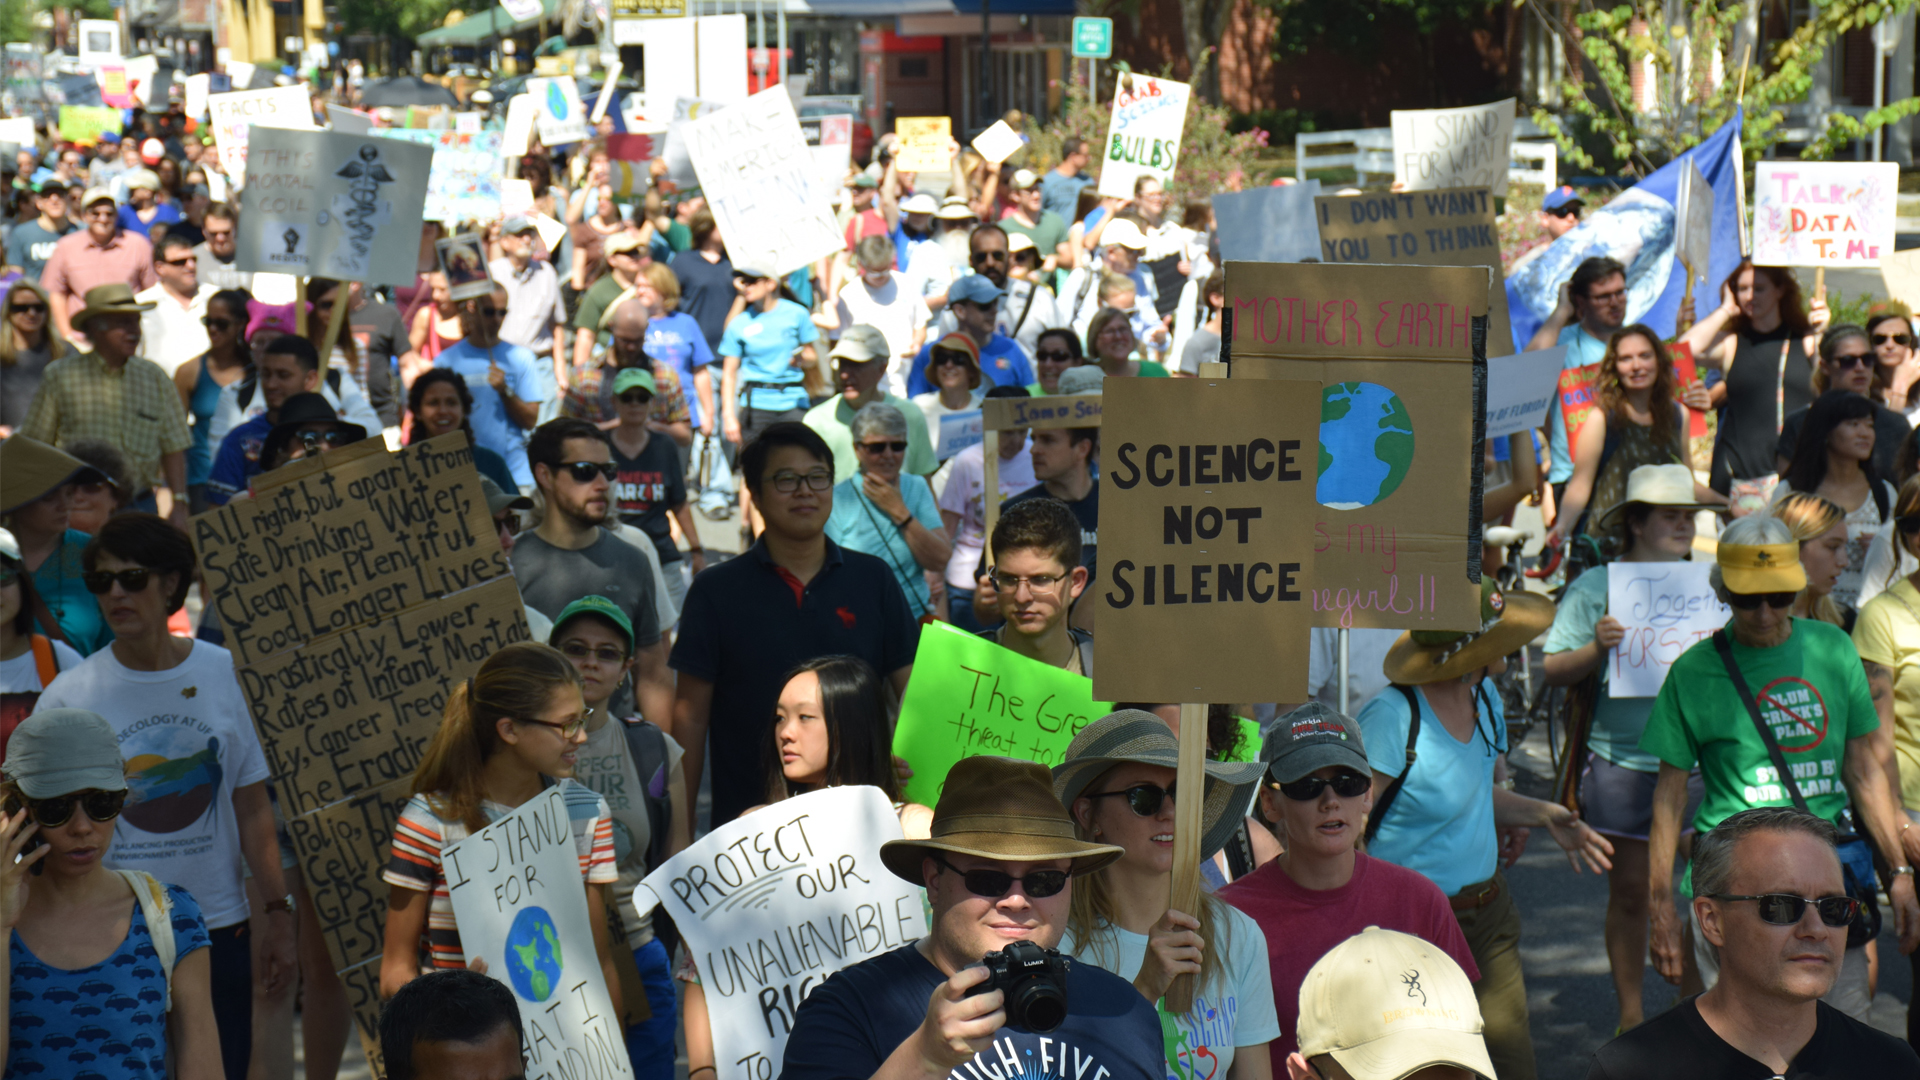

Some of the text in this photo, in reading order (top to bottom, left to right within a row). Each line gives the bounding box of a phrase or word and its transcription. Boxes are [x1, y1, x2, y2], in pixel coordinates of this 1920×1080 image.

[218, 97, 276, 118] FACTS
[1435, 110, 1499, 149] STAND
[259, 149, 313, 168] THIS
[1109, 133, 1176, 171] BULBS
[1404, 151, 1442, 183] FOR
[1448, 137, 1495, 174] WHAT
[247, 173, 313, 190] MORTAL
[259, 196, 308, 214] COIL
[1322, 190, 1489, 225] I DON'T WANT
[1325, 224, 1494, 262] YOU TO THINK
[1233, 296, 1470, 349] MOTHER EARTH
[1014, 401, 1028, 425] I
[1075, 400, 1102, 419] Sci
[1110, 438, 1301, 489] SCIENCE
[195, 504, 249, 553] All
[298, 471, 344, 516] but
[348, 449, 418, 511] apart
[415, 442, 473, 478] from
[615, 483, 665, 501] ARCH
[203, 480, 470, 595] Safe Drinking Water,
[1163, 505, 1262, 545] NOT
[215, 511, 475, 629] Clean Air, Plentiful
[1347, 524, 1396, 575] my
[1105, 560, 1301, 609] SILENCE
[1312, 574, 1435, 629] egirl!!
[1626, 571, 1731, 628] Togeth
[233, 551, 508, 664] Food, Longer Lives
[239, 601, 480, 702] Drastically Lower
[251, 692, 329, 739] Rates
[333, 669, 358, 709] of
[360, 643, 440, 699] Infant
[960, 664, 1088, 737] The Gre
[1767, 689, 1810, 708] PLUM
[181, 716, 197, 727] AT
[197, 722, 214, 736] UF
[265, 674, 450, 778] ity, Cancer Treat
[947, 712, 1017, 757] threat
[1029, 738, 1053, 766] to
[1291, 722, 1345, 735] FIRE TEAM
[331, 729, 427, 796] Eradic
[576, 753, 622, 773] PECT
[578, 773, 626, 795] UR
[1756, 761, 1818, 784] STND
[1744, 784, 1782, 803] OUR
[111, 850, 177, 861] ENVIRONMENT
[114, 835, 213, 851] BALANCING PRODUCTION
[292, 813, 362, 857] Polio,
[444, 846, 470, 891] I
[482, 791, 569, 873] STAND
[306, 838, 369, 887] Cell
[670, 814, 814, 914] PROTECT
[796, 855, 870, 899] OUR
[314, 873, 386, 924] GPS,
[494, 864, 544, 913] FOR
[708, 895, 920, 997] UNALIENABLE
[1023, 959, 1044, 967] LUMIX
[522, 1001, 565, 1071] HAT
[571, 980, 598, 1025] I
[1382, 1006, 1459, 1025] BROWNING
[736, 1051, 772, 1080] TO
